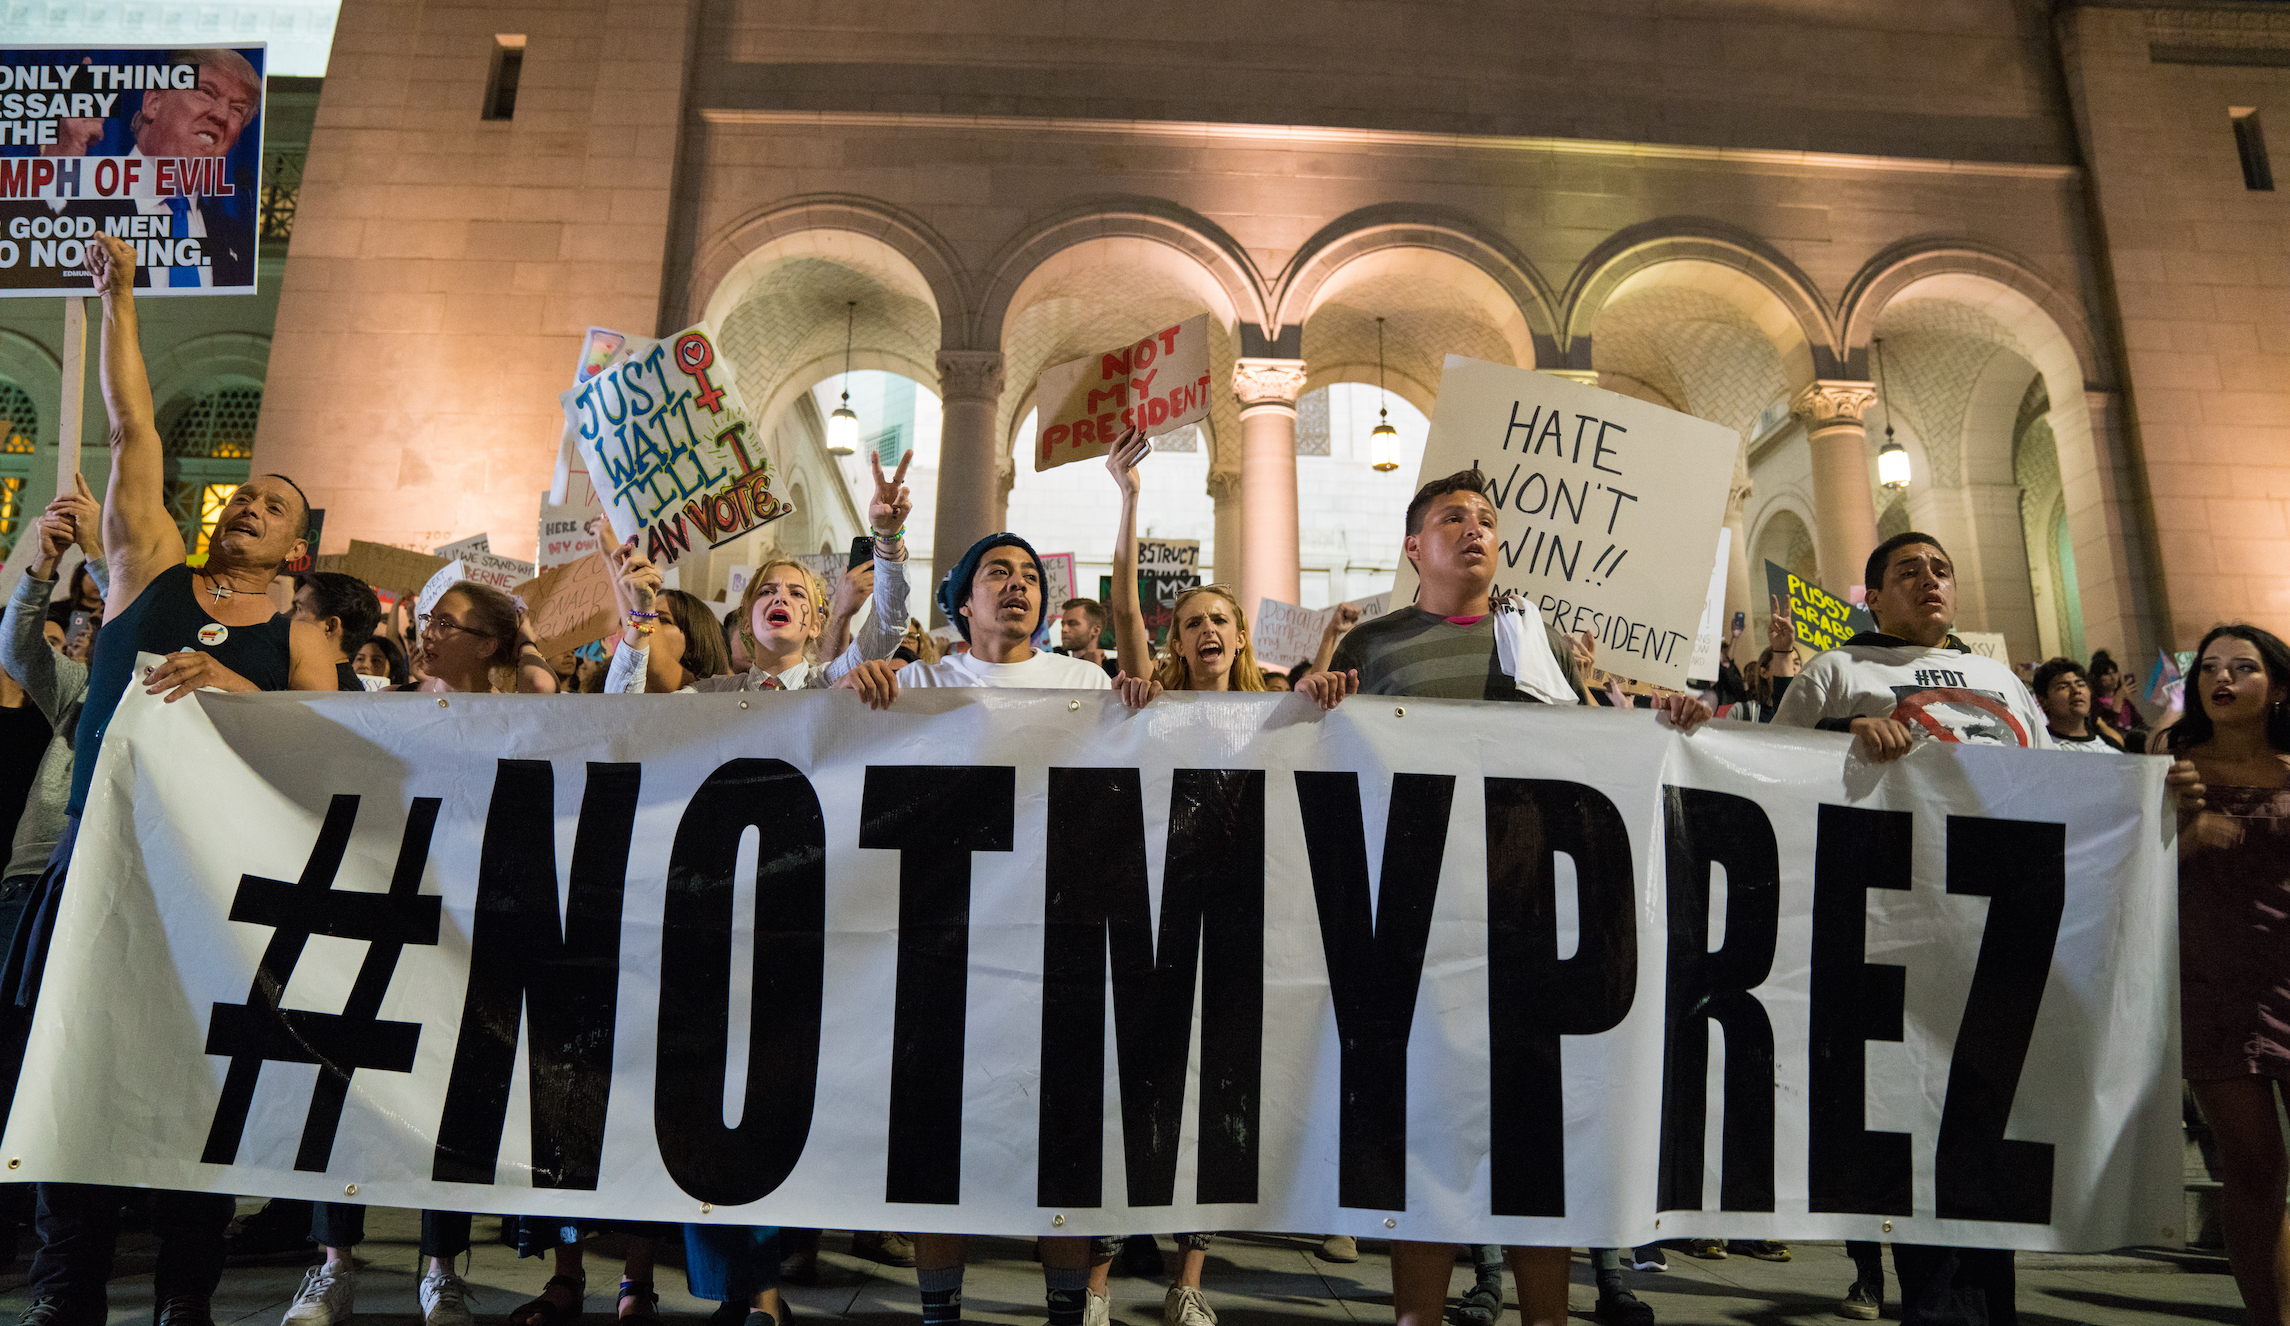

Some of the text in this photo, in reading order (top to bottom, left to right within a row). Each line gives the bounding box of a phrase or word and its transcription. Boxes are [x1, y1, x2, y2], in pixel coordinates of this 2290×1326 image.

[87, 64, 195, 90] THING
[0, 93, 119, 119] SSARY
[94, 158, 142, 197] OF
[155, 156, 235, 198] EVIL
[9, 215, 170, 239] GOOD MEN
[30, 239, 211, 268] NOING.
[1102, 324, 1181, 381] NOT
[575, 343, 676, 440] JUST
[1087, 368, 1158, 415] MY
[1042, 370, 1211, 461] PRESIDENT
[594, 389, 701, 490] WAIT
[1502, 400, 1628, 476] HATE
[613, 449, 728, 529] TILL
[714, 420, 768, 487] I
[682, 475, 792, 543] VOTE.
[1473, 460, 1638, 535] WON'T
[546, 520, 577, 536] HERE
[548, 541, 572, 555] MY
[461, 551, 479, 563] WE
[481, 556, 516, 571] STAND
[466, 567, 517, 588] BERNIE
[1049, 584, 1068, 599] CK
[1787, 573, 1851, 622] PUSSY
[538, 604, 601, 643] RUMP
[1264, 599, 1325, 635] Donald
[1539, 595, 1688, 668] PRESIDENT.
[1790, 596, 1856, 641] GRABS
[1795, 620, 1841, 651] BAC
[1971, 642, 1996, 658] SSY
[1914, 669, 1968, 688] #FDT
[201, 757, 2068, 1227] #NOTMYPREZ
